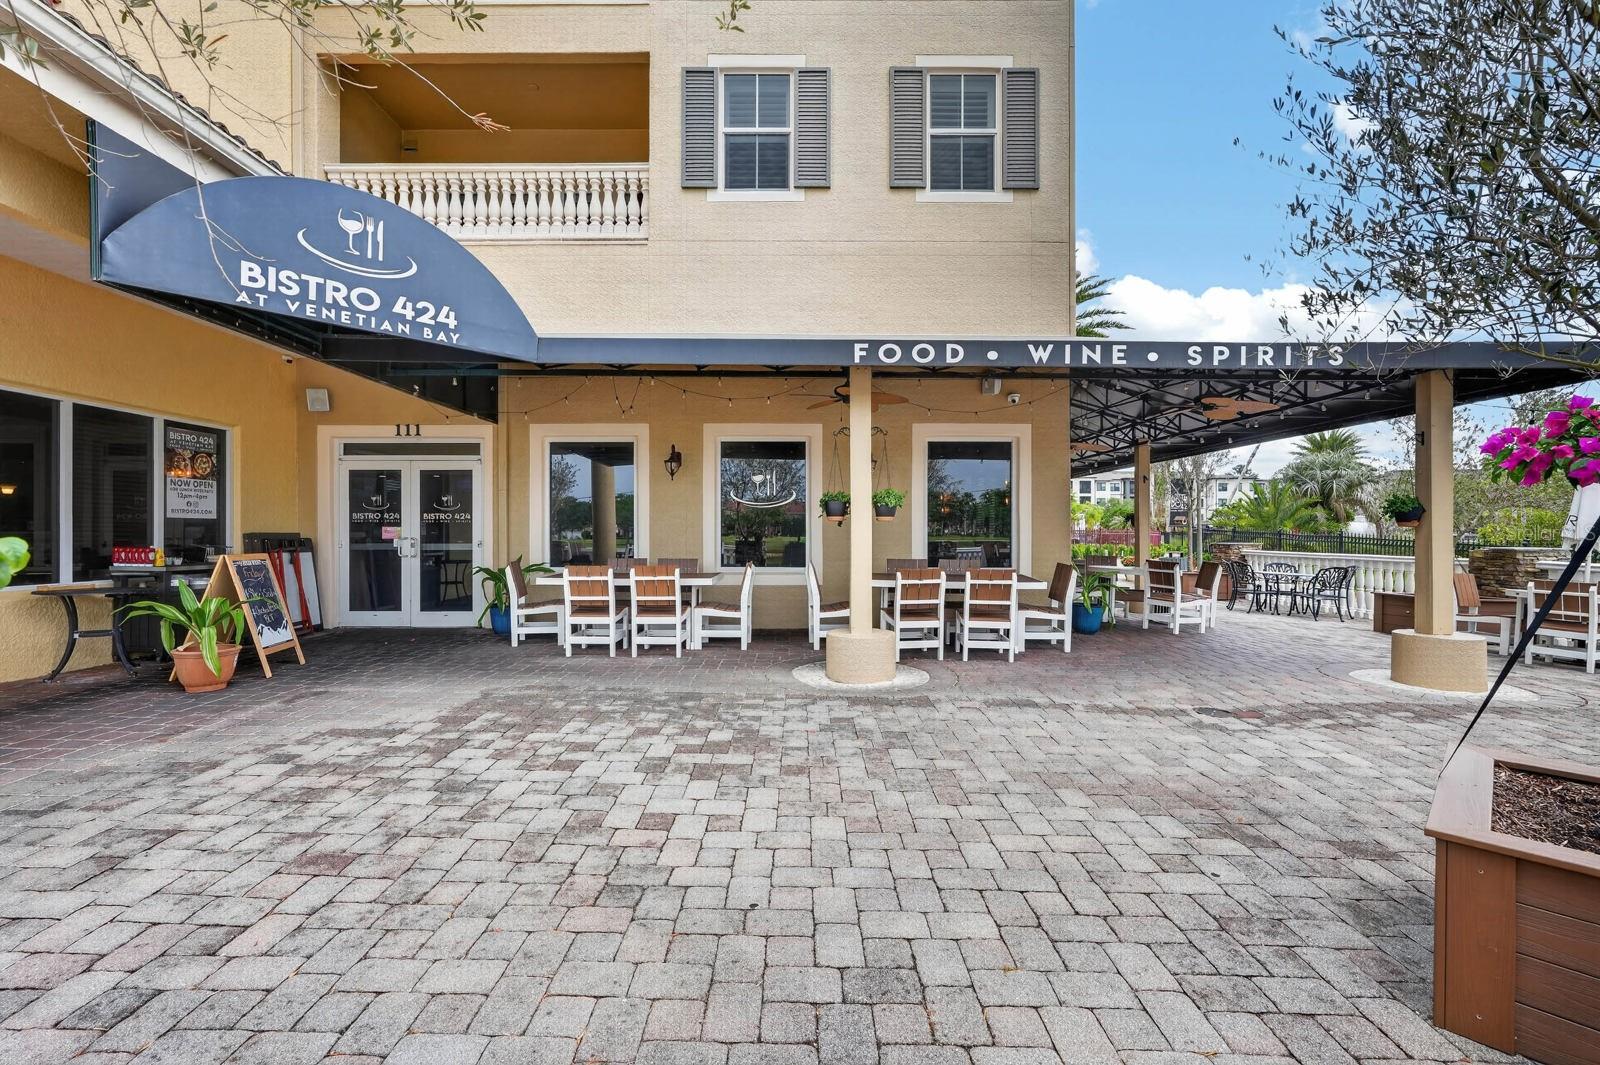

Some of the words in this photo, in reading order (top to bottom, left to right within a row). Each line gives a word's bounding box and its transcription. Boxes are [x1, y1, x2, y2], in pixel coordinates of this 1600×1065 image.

[240, 259, 381, 312] BISTRO
[391, 295, 458, 329] 424
[235, 290, 268, 307] AT
[285, 299, 410, 335] VENETIAN
[423, 327, 461, 344] BAY
[853, 343, 965, 364] FOOD
[1027, 343, 1127, 365] WINE
[1187, 344, 1344, 367] SPIRITS
[169, 432, 197, 443] BISTRO
[199, 436, 214, 445] 424
[394, 424, 421, 437] 111
[169, 479, 191, 487] NOW
[193, 480, 214, 489] OPEN
